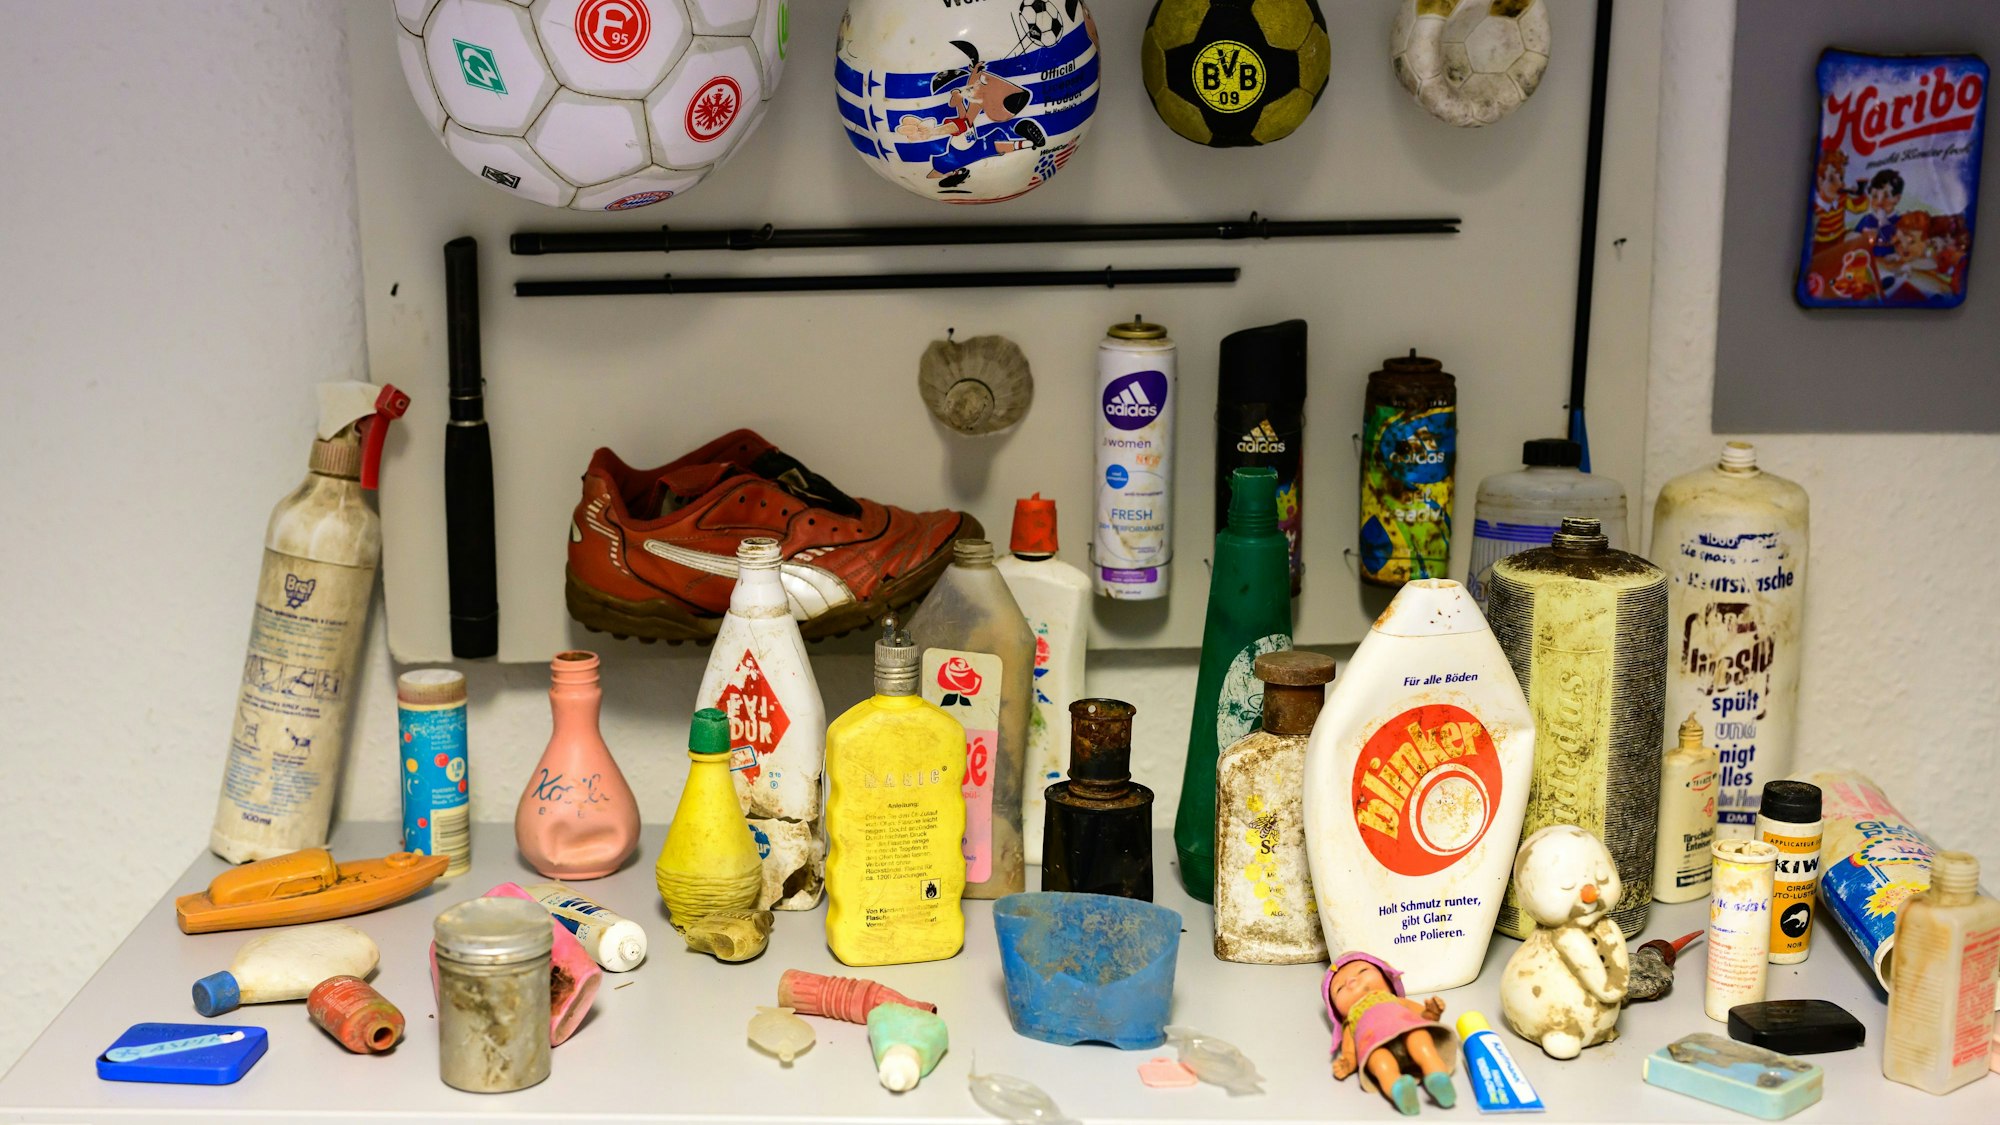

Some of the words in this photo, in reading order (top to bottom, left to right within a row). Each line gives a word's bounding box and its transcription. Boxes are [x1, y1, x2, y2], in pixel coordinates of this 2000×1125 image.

[611, 32, 629, 45] 95
[1041, 59, 1076, 80] Official
[1203, 49, 1258, 91] BVB
[1219, 92, 1239, 104] 09
[1822, 67, 1983, 156] Haribo
[1105, 403, 1158, 417] adidas
[1237, 441, 1286, 453] adidas
[1112, 508, 1153, 521] FRESH
[1403, 676, 1420, 687] Für
[1423, 675, 1442, 686] alle
[1445, 672, 1479, 684] Böden
[730, 717, 772, 744] DUR
[1357, 721, 1482, 841] blinker
[1726, 813, 1748, 823] DM
[1770, 838, 1814, 848] APPLICATEUR
[1786, 882, 1814, 892] CIRAGE
[1379, 903, 1398, 916] Holt
[1400, 898, 1441, 913] Schmutz
[1445, 896, 1481, 907] runter,
[1402, 915, 1420, 930] gibt
[1423, 912, 1453, 924] Glanz
[1394, 933, 1417, 945] ohne
[1420, 928, 1465, 941] Polieren.
